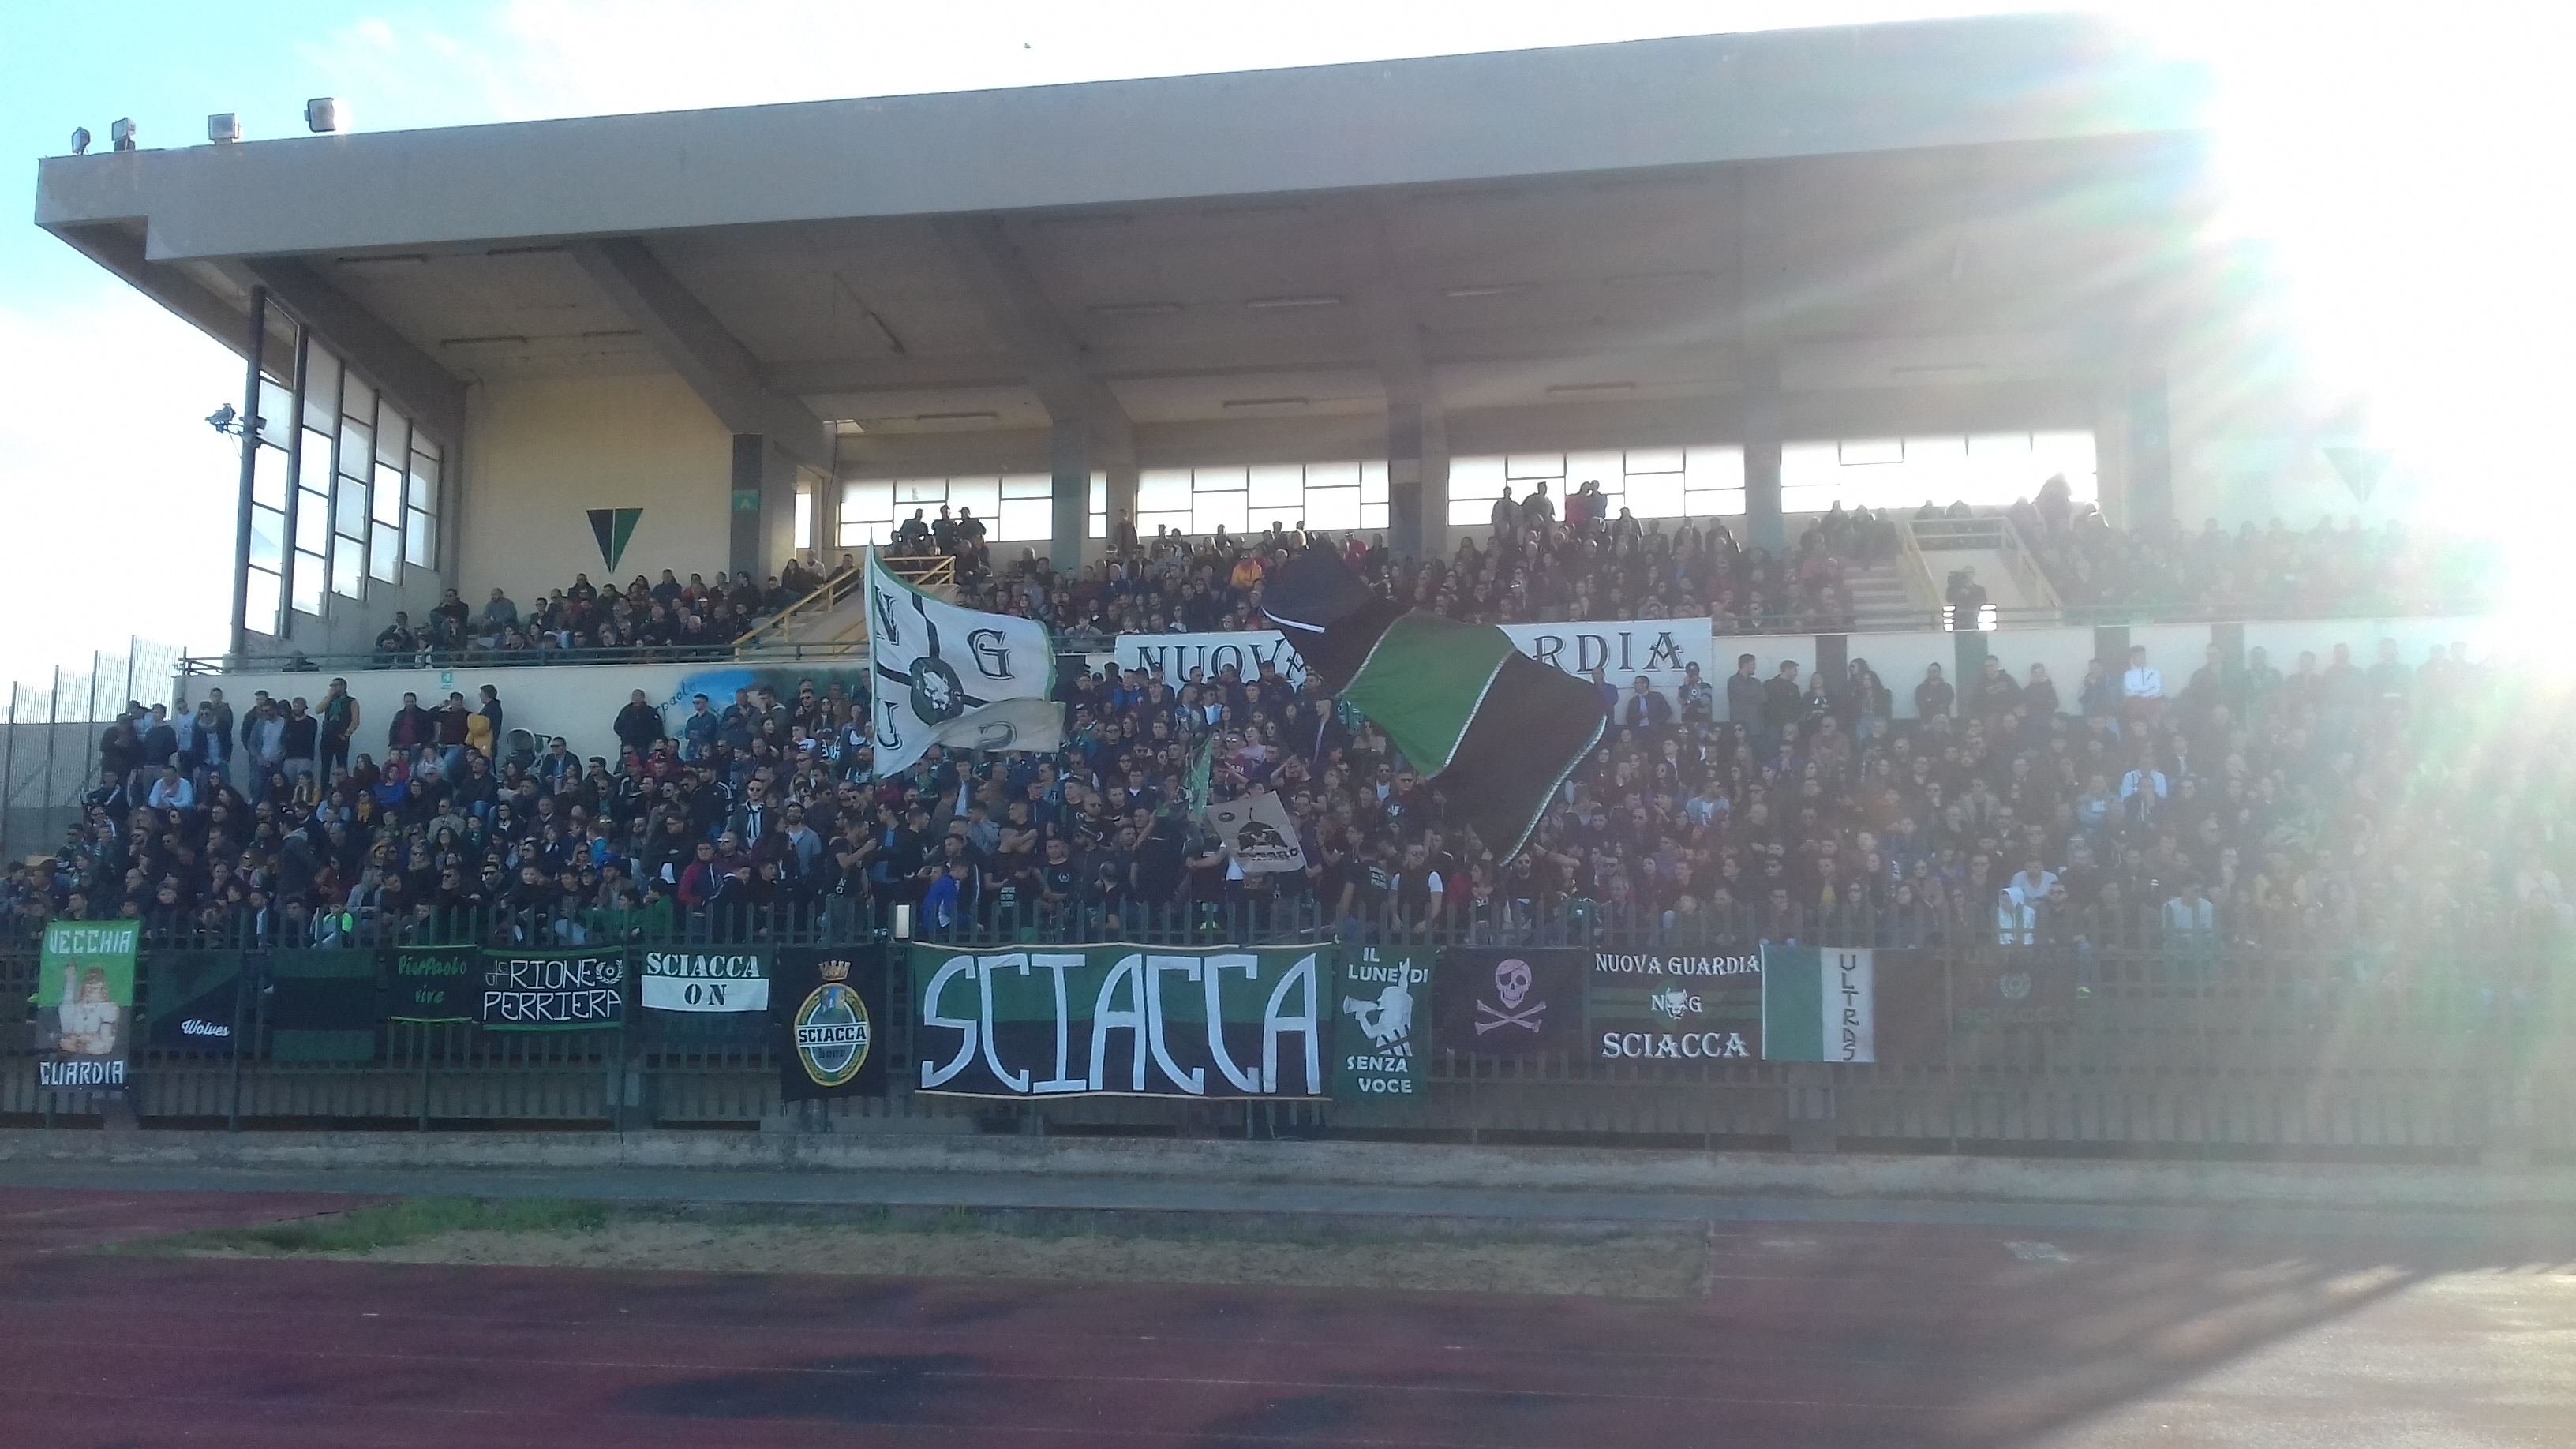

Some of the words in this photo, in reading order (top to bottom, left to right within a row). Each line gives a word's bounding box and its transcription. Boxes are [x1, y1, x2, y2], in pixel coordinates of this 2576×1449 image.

[967, 628, 1015, 681] G
[1533, 631, 1687, 673] RDIA
[48, 929, 132, 954] VECCHIA
[1363, 947, 1380, 962] IL
[509, 958, 597, 989] RIONE
[646, 952, 760, 978] SCIACCA
[1595, 953, 1663, 975] NUOVA
[1668, 954, 1761, 975] GUARDIA
[483, 990, 622, 1021] PERRIERA
[684, 983, 728, 1006] ON
[1840, 954, 1860, 1061] ULTRAS
[181, 1019, 230, 1038] Wolves
[798, 1025, 867, 1044] SCIACCA
[922, 953, 1321, 1095] SCIACCA
[1601, 1032, 1750, 1059] SCIACCA
[39, 1060, 124, 1086] GUARDIA
[1346, 1055, 1408, 1073] SENZA
[1358, 1077, 1413, 1094] VOCE
